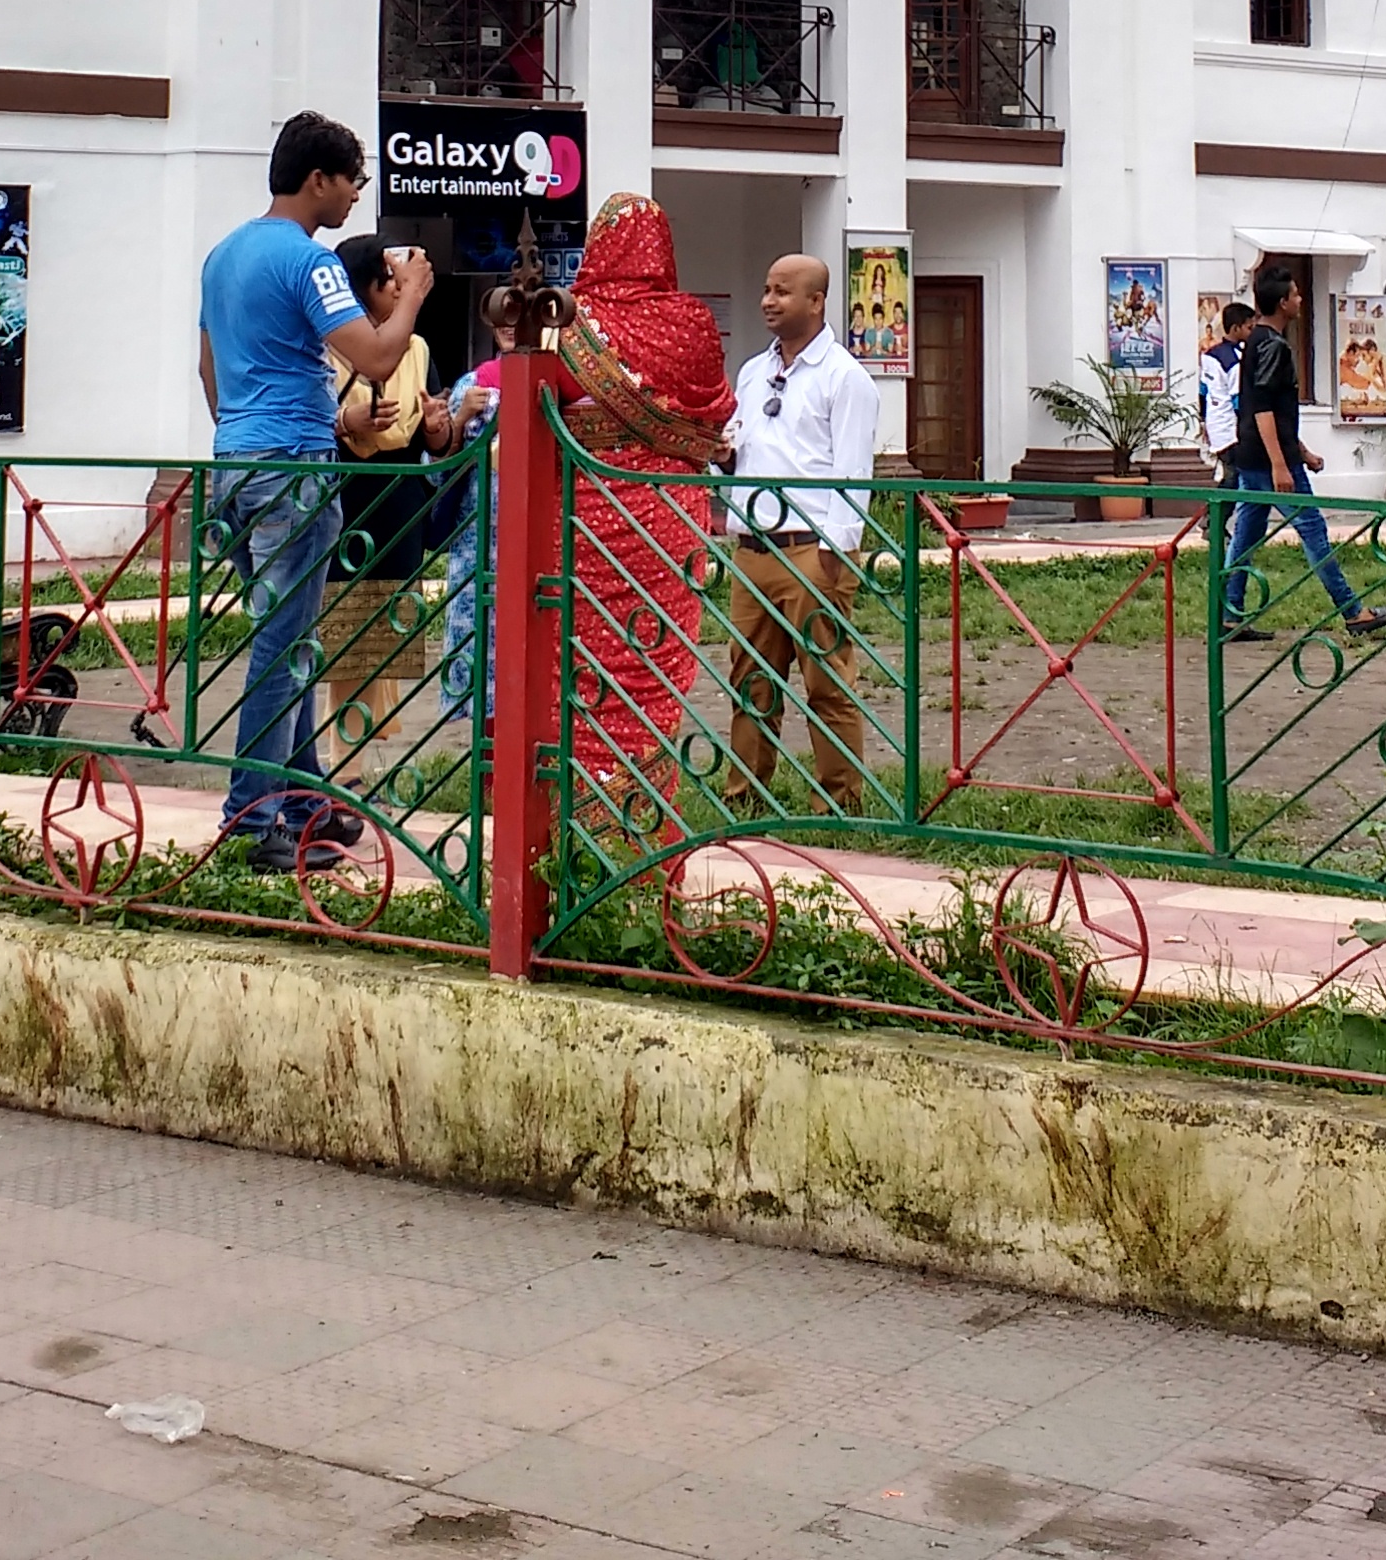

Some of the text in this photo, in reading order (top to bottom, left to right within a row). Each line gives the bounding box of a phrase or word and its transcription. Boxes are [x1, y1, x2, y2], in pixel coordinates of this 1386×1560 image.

[387, 130, 582, 199] Galaxy 9D
[389, 173, 522, 197] Entertainment
[886, 364, 907, 374] SOON
